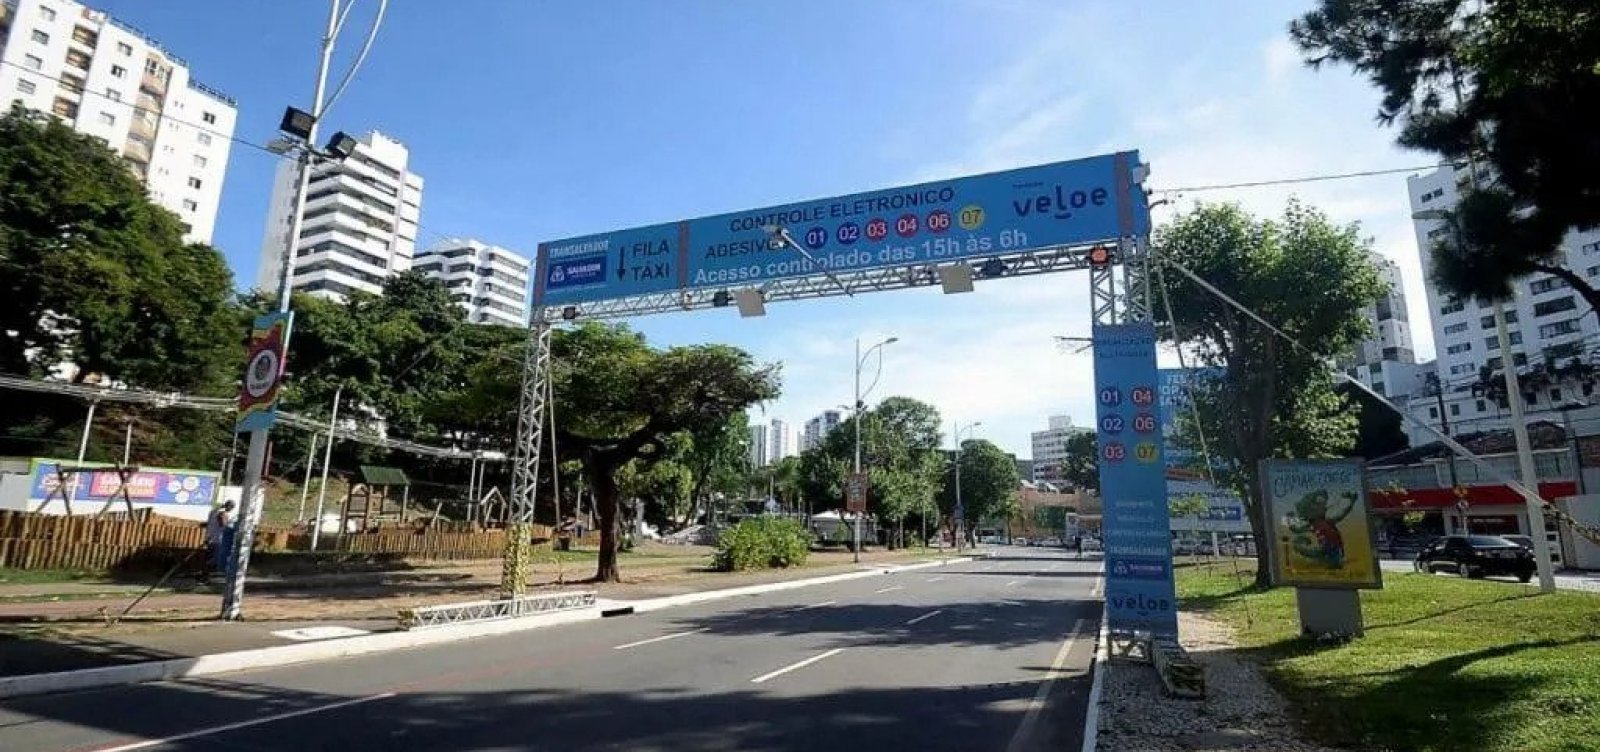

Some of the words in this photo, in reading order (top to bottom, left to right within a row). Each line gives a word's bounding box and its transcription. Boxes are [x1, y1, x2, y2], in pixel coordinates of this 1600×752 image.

[1013, 184, 1108, 219] veloe
[729, 206, 825, 232] CONTROLE
[807, 232, 825, 245] 01
[838, 226, 857, 240] 02
[866, 222, 886, 237] 03
[897, 217, 917, 232] 04
[961, 209, 981, 225] 07
[633, 239, 670, 257] FILA
[694, 266, 761, 284] Acesso
[766, 248, 872, 276] controlado
[878, 243, 916, 263] das
[923, 236, 960, 258] 15h
[966, 231, 992, 251] às
[999, 228, 1027, 249] 6h
[1101, 390, 1119, 402] 01
[1133, 390, 1152, 403] 04
[1103, 418, 1122, 431] 02
[1135, 417, 1154, 431] 06
[1104, 445, 1125, 459] 03
[1113, 593, 1169, 616] veloe
